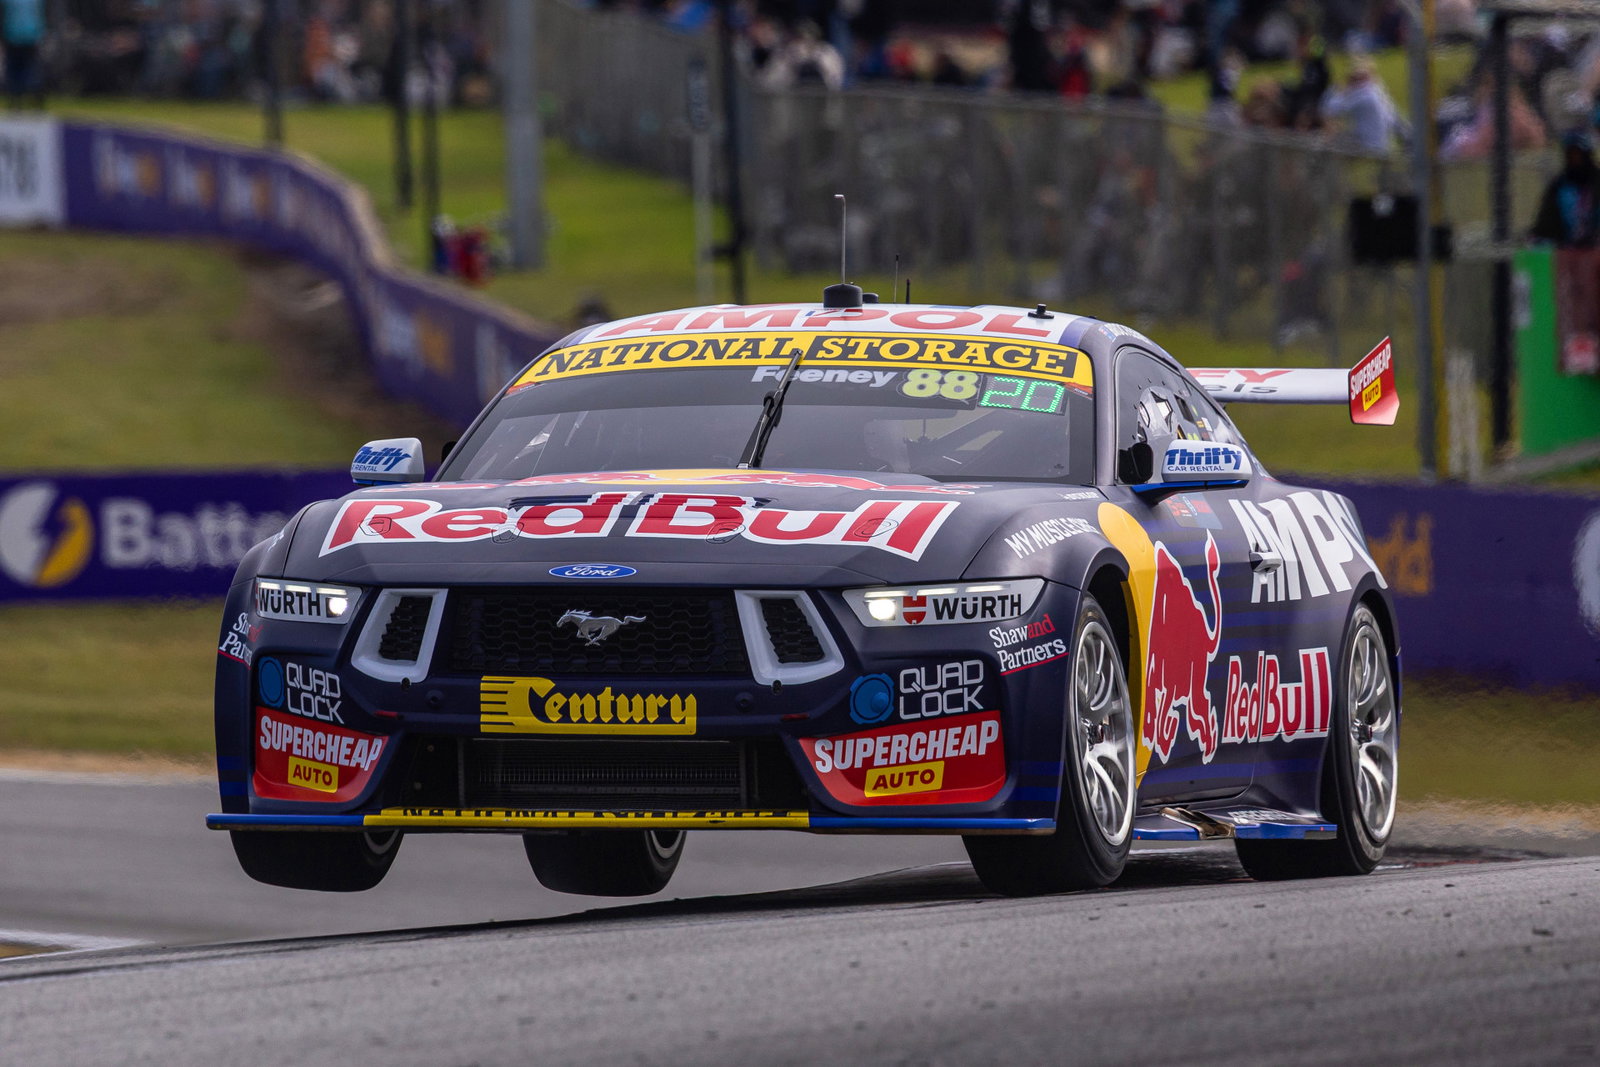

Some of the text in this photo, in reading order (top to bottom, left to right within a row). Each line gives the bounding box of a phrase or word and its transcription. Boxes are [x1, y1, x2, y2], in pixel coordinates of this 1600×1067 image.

[595, 307, 1052, 338] AMPOL
[535, 336, 1069, 377] NATIONAL STORAGE
[1351, 343, 1391, 400] SUPERCHEAP
[902, 368, 979, 400] 88
[981, 376, 1066, 413] 20
[1364, 384, 1380, 403] AUTO
[353, 446, 412, 472] Thrifty
[1165, 447, 1242, 470] Thrifty
[1167, 465, 1225, 473] CAR RENTAL
[321, 492, 957, 560] Red Bull
[1004, 530, 1036, 559] MY
[564, 565, 620, 577] Ford
[258, 587, 321, 617] WÜRTH
[932, 594, 1022, 620] WÜRTH
[997, 639, 1067, 672] Partners
[286, 662, 341, 698] QUAD
[900, 660, 984, 693] QUAD
[287, 687, 344, 724] LOCK
[480, 675, 697, 735] Century
[900, 685, 984, 720] LOCK
[1222, 646, 1332, 744] Red Bull
[260, 715, 383, 771] SUPERCHEAP
[814, 720, 999, 774] SUPERCHEAP
[292, 764, 333, 786] AUTO
[872, 769, 936, 790] AUTO
